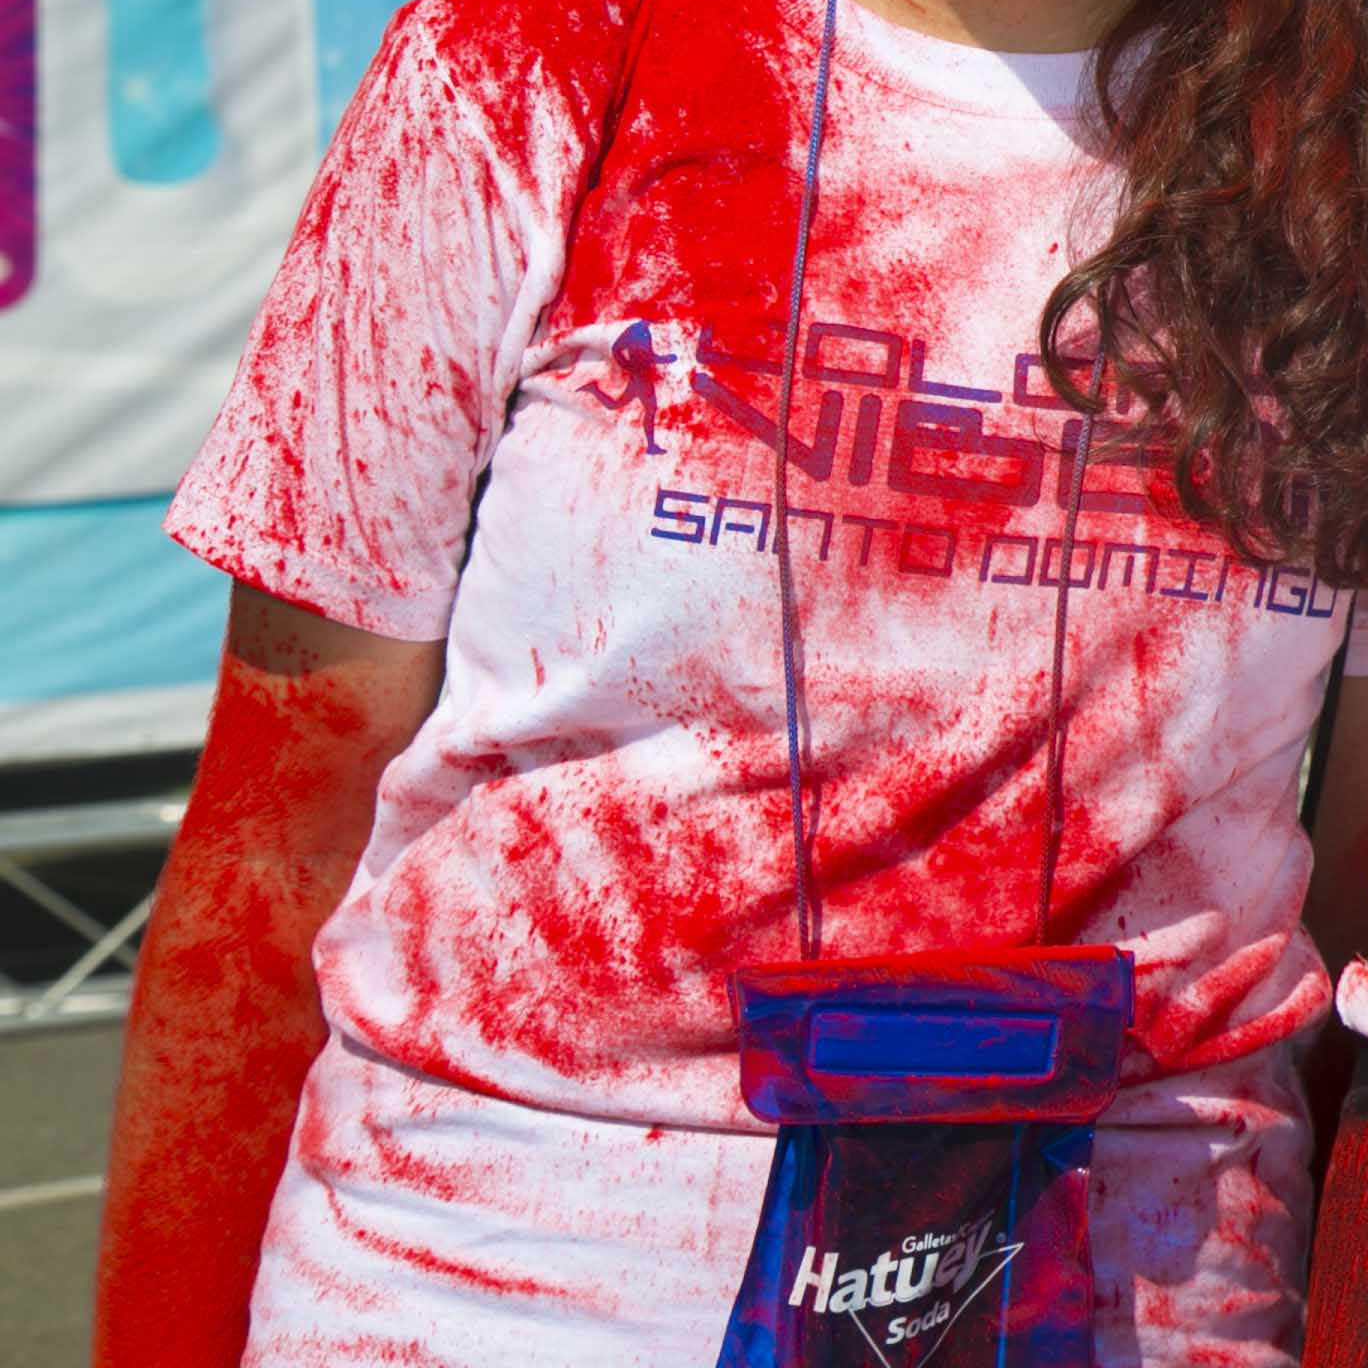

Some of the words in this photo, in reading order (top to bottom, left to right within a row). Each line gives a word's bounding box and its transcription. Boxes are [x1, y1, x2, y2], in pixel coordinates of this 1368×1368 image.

[696, 316, 1180, 414] COLO
[652, 489, 953, 578] SANTO
[980, 535, 1338, 618] DOMINGO
[788, 1220, 993, 1314] Hatuey
[885, 1300, 950, 1345] Soda
